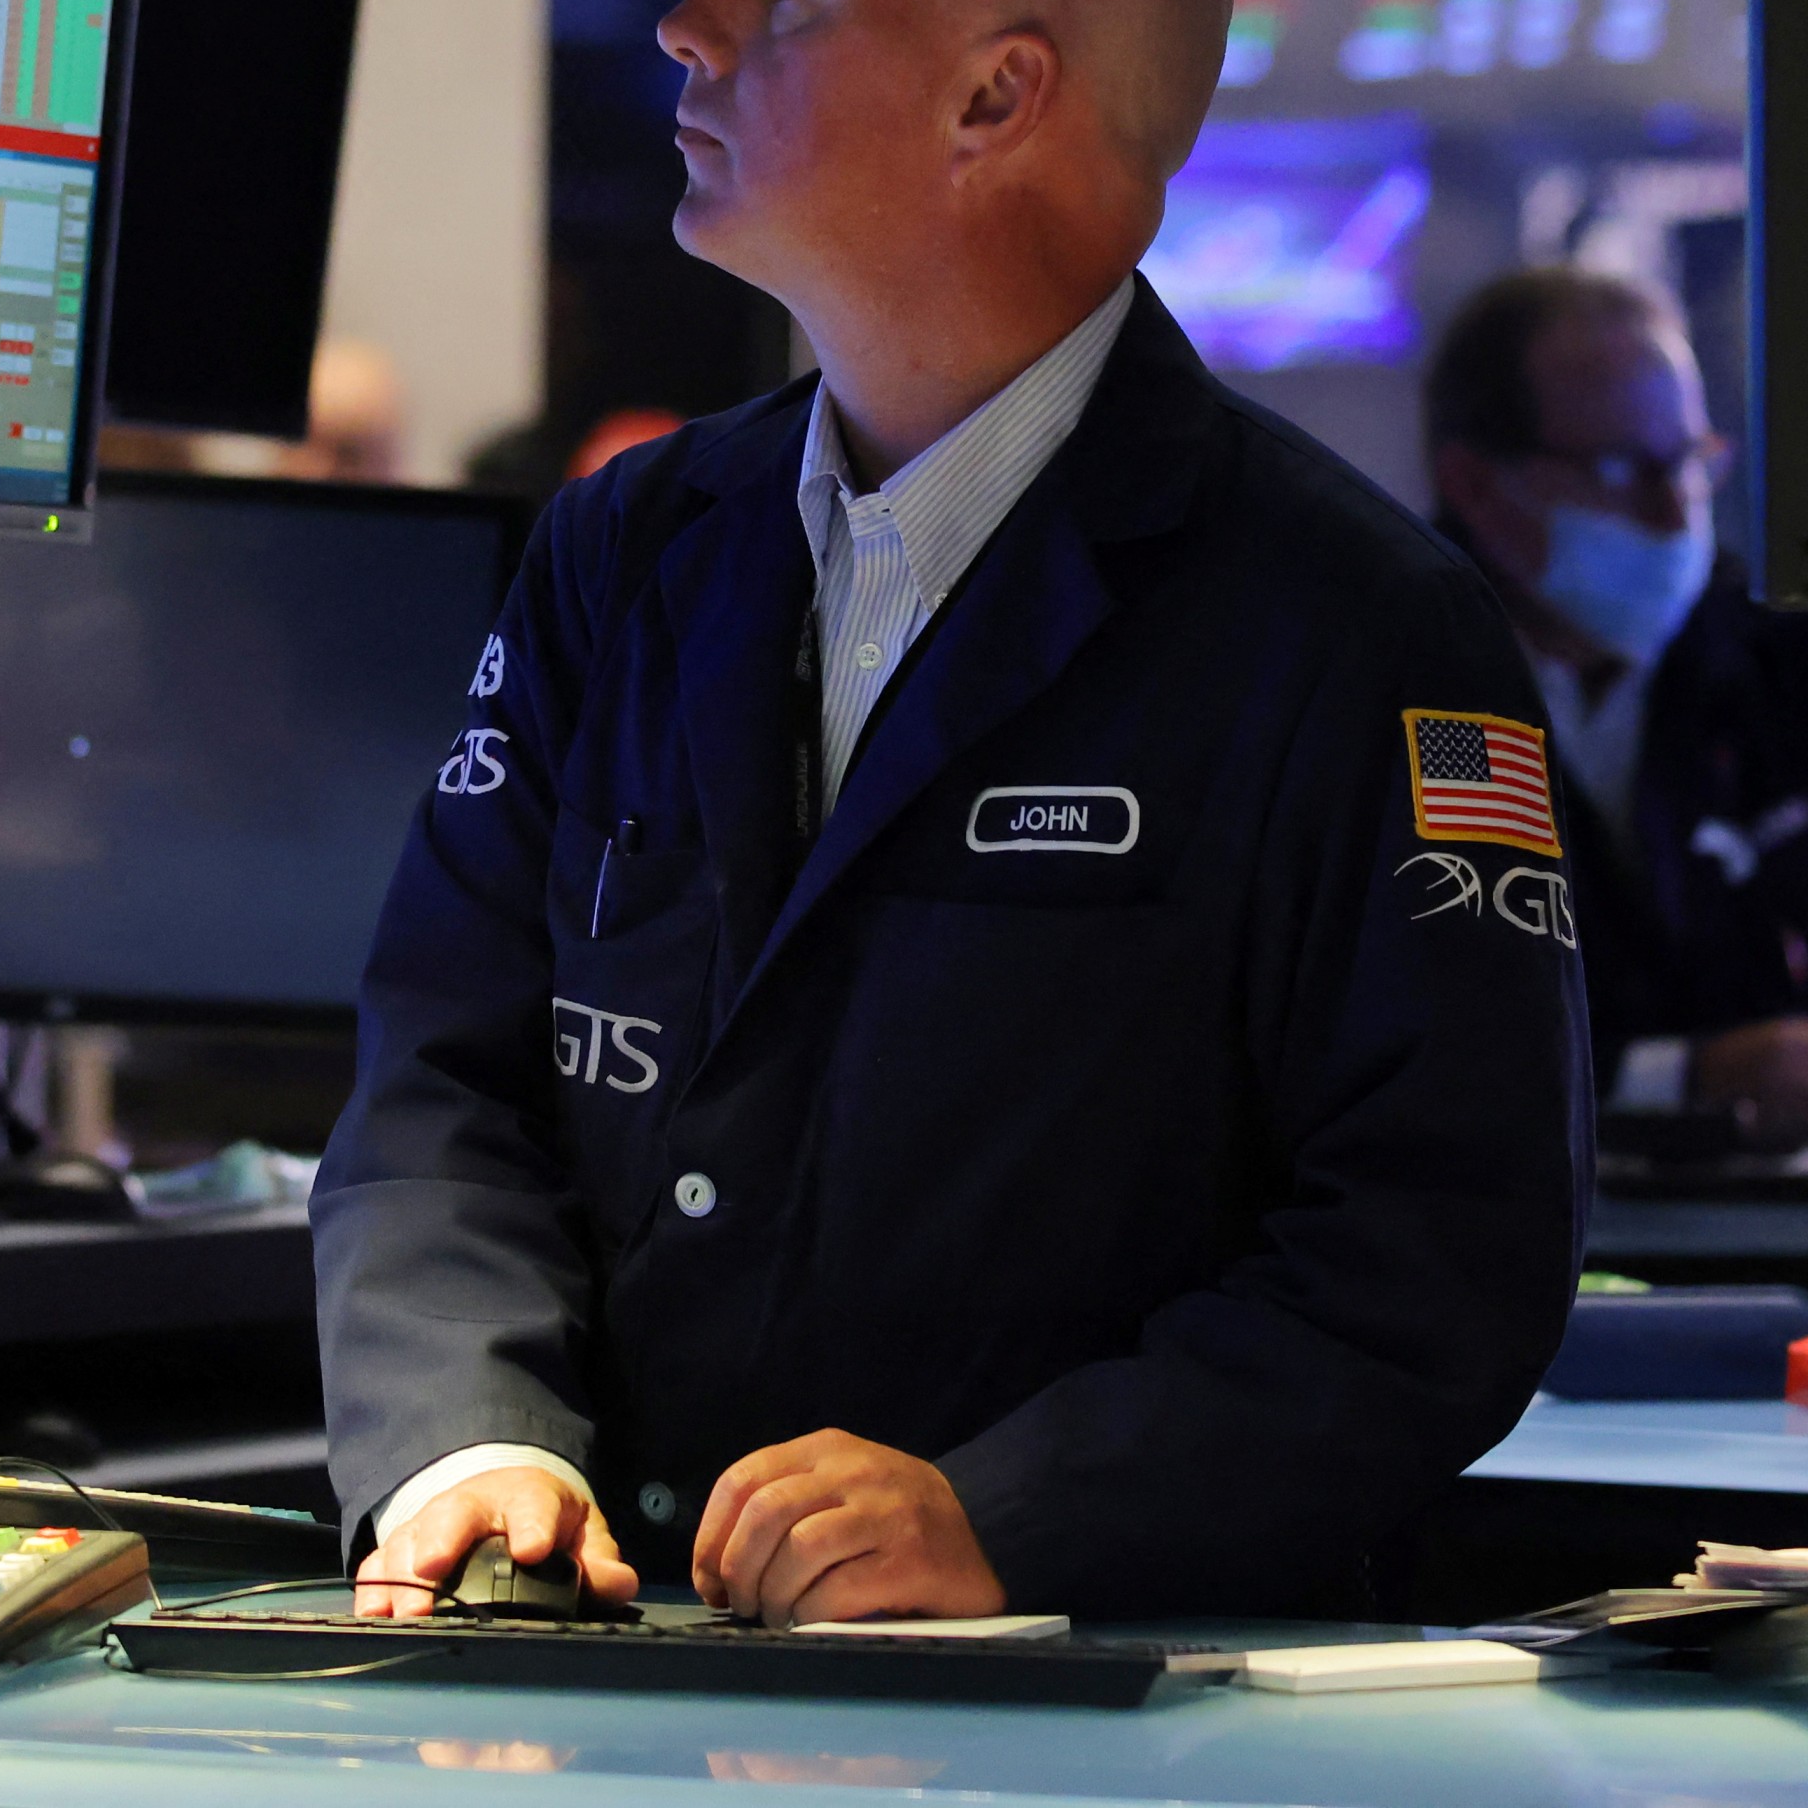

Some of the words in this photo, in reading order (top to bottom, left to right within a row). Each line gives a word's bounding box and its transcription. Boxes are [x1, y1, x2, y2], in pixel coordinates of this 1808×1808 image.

[1009, 805, 1089, 832] JOHN
[1492, 866, 1577, 950] GTS
[552, 996, 663, 1094] GTS
